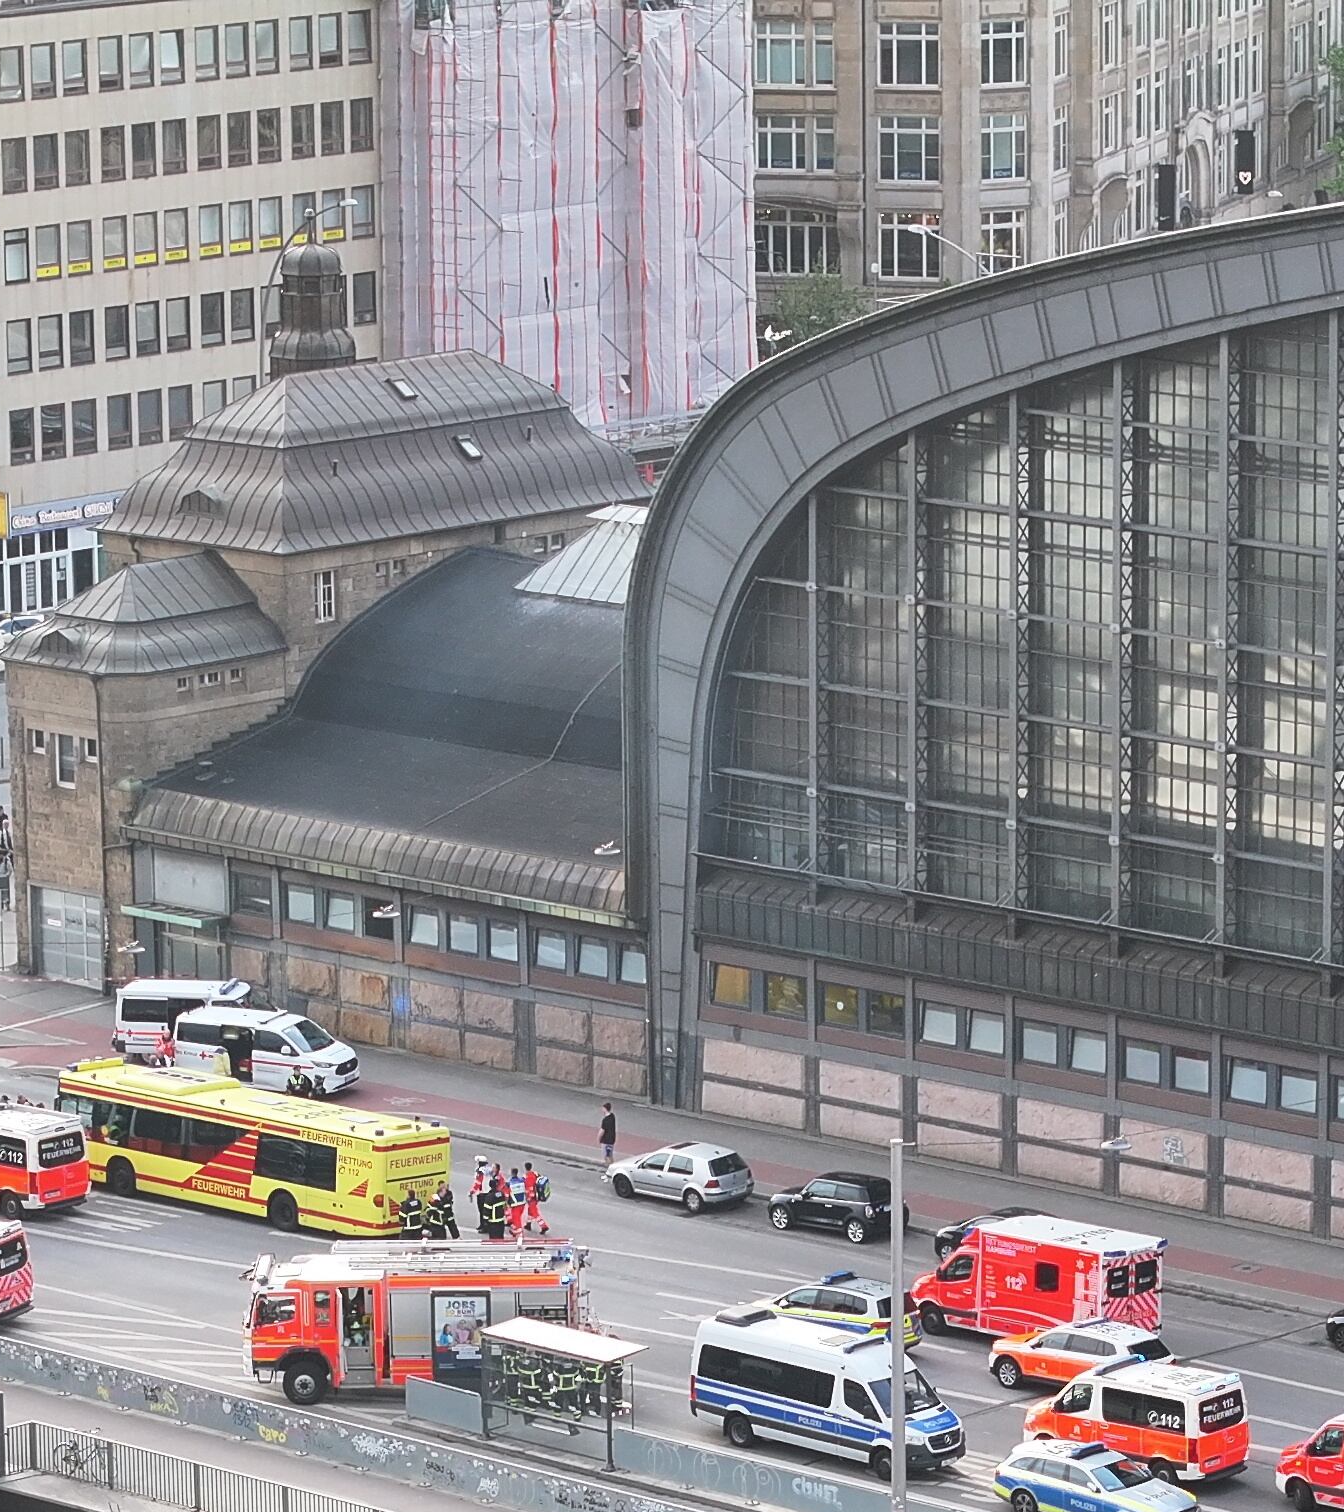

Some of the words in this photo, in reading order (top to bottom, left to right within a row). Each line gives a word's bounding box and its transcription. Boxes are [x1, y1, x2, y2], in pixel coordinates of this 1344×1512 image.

[300, 1131, 354, 1150] FEUERWEHR
[8, 1149, 24, 1165] 112
[338, 1154, 373, 1171] RETTUNG
[390, 1152, 444, 1170] FEUERWEHR
[193, 1179, 247, 1200] FEUERWEHR
[400, 1179, 435, 1192] RETTUNG
[1005, 1274, 1023, 1291] 112
[1222, 1397, 1235, 1410] 112
[1160, 1413, 1181, 1429] 112
[1070, 1497, 1097, 1512] POLIZEI
